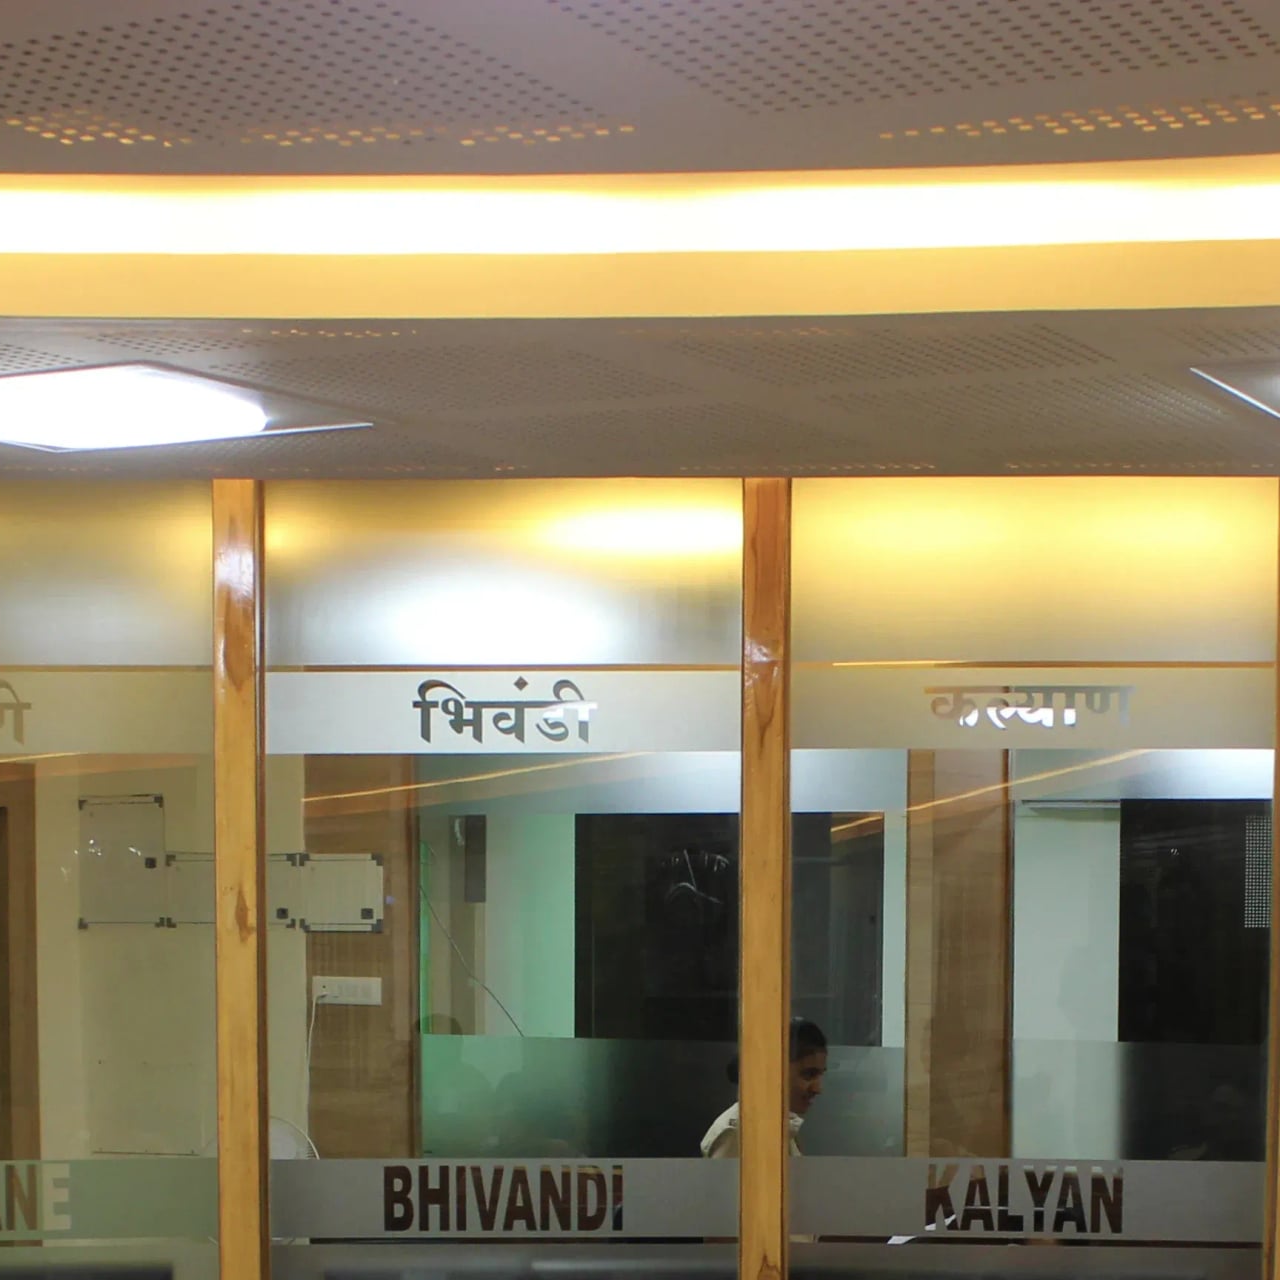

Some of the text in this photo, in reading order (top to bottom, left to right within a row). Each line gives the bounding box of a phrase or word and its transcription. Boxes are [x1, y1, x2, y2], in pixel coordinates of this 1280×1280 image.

[412, 675, 598, 744] भिवंडी
[924, 685, 1134, 730] कल्याण
[383, 1165, 624, 1232] BHIVANDI
[924, 1164, 1124, 1234] KALYAN
